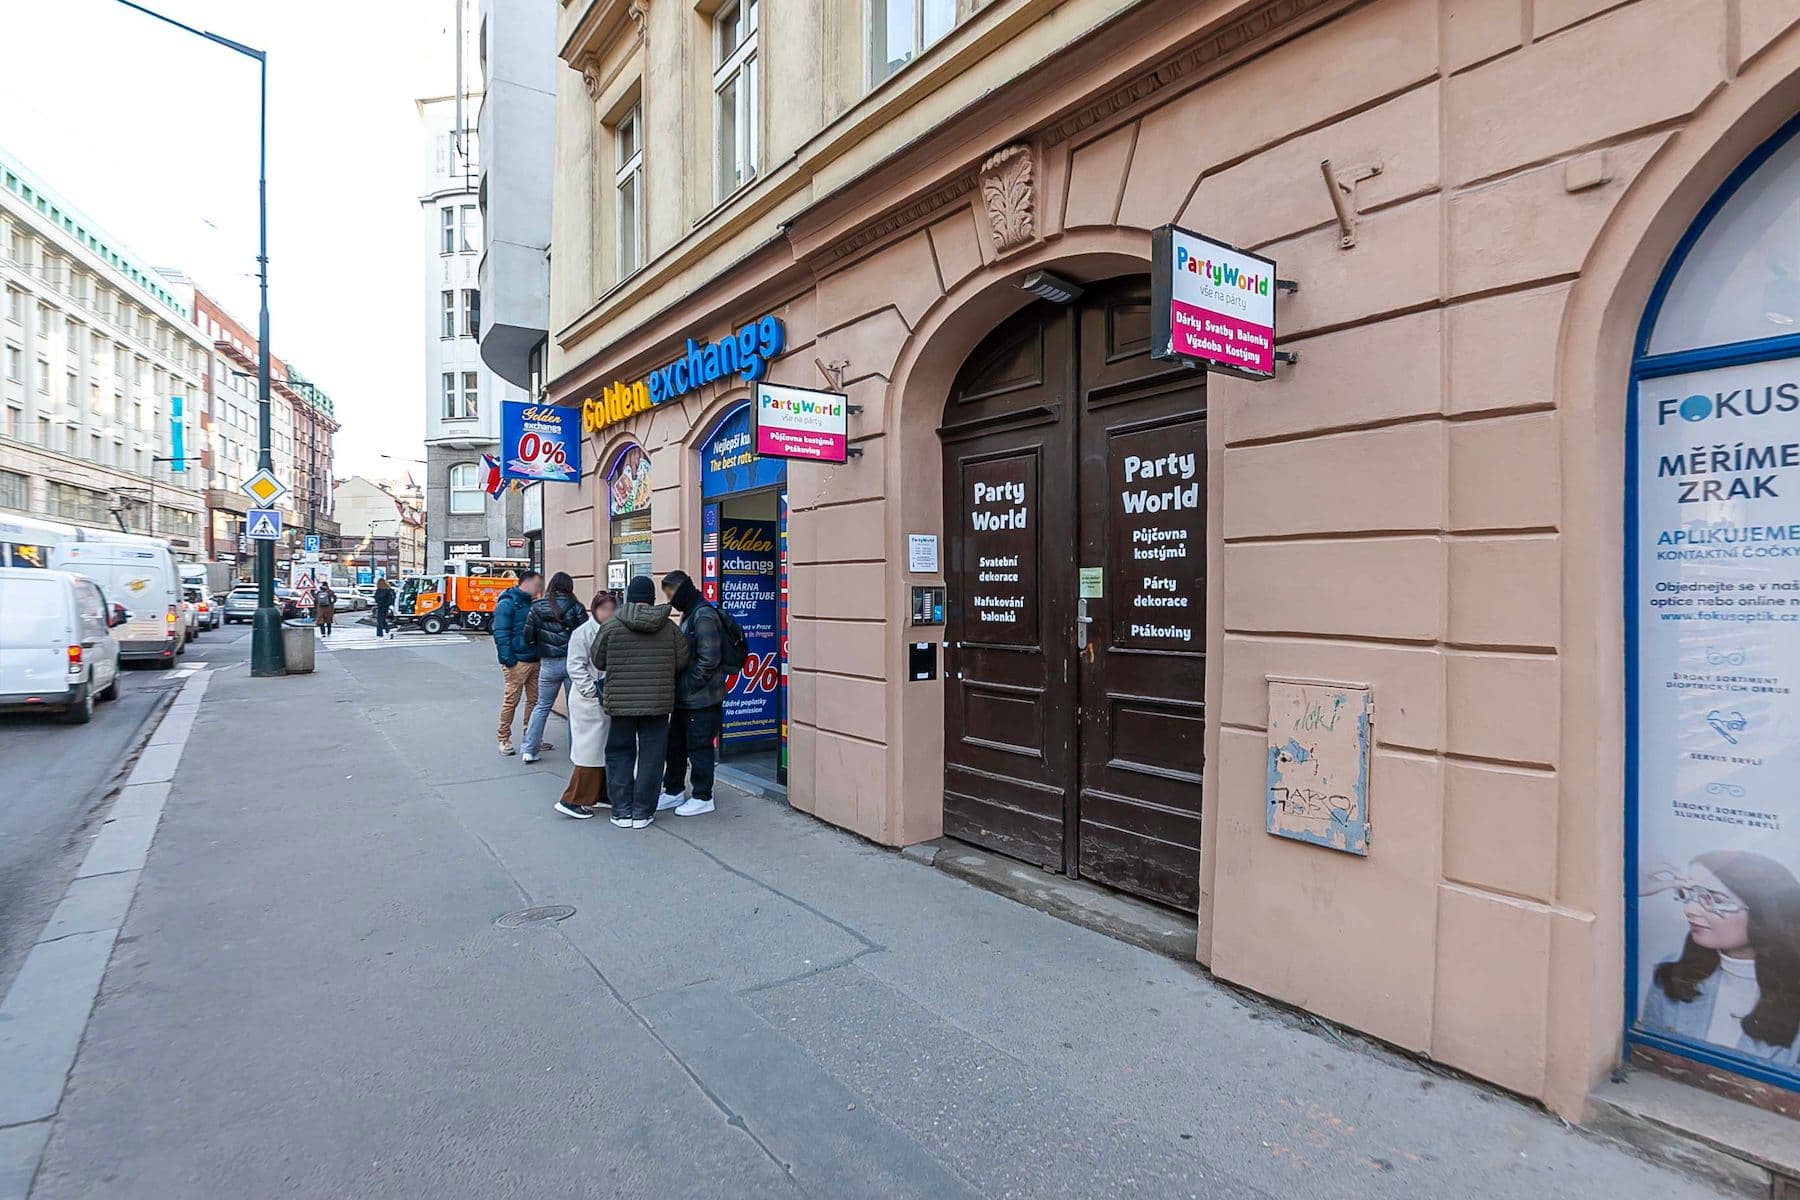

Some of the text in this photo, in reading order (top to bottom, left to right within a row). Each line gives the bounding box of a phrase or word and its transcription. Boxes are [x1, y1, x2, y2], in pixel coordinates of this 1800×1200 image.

[1199, 285, 1213, 297] vše
[1214, 290, 1224, 301] na
[1176, 311, 1269, 349] Dárky Svatby Balonky
[1186, 333, 1261, 364] Výzdoba Kostýmy
[522, 406, 562, 423] Golden
[583, 380, 650, 433] Golden
[713, 432, 751, 456] Nejlepší ku
[770, 431, 834, 446] Půjčovna kostýmů
[518, 431, 566, 466] 0%
[785, 444, 821, 456] Ptákoviny
[711, 459, 721, 472] The
[722, 455, 737, 469] best
[1124, 452, 1196, 483] Party
[1658, 442, 1800, 478] MĚŘÍME
[974, 481, 1025, 505] Party
[1678, 475, 1779, 503] ZRAK
[1122, 483, 1199, 514] World
[972, 507, 1027, 531] World
[722, 526, 773, 552] Golden
[1133, 527, 1187, 545] Půjčovna
[1657, 525, 1800, 546] APLIKUJEME
[1134, 543, 1186, 561] kostýmů
[1657, 545, 1800, 561] KONTAKTNÍ ČOČKY
[979, 555, 1019, 567] Svatební
[979, 571, 1018, 582] dekorace
[1143, 576, 1177, 592] Párty
[1655, 582, 1734, 594] Objednejte
[1739, 583, 1755, 591] se
[1772, 580, 1800, 591] naš
[722, 592, 775, 601] CHSELSTUBE
[974, 596, 1024, 608] Nafukování
[1134, 595, 1188, 607] dekorace
[1650, 597, 1693, 608] optice
[1697, 596, 1733, 606] nebo
[1738, 595, 1785, 606] online
[981, 610, 1016, 623] balonků
[1661, 611, 1799, 624] www.fokusoptik.cz
[1131, 624, 1192, 641] Ptákoviny
[1666, 681, 1747, 692] DIOPTRICKÝCH
[1673, 672, 1779, 685] ŠIROKÝ SORTIMENT
[1690, 753, 1727, 762] SERVIS
[1672, 800, 1779, 820] ŠIROKÝ SORTIMENT
[1674, 810, 1744, 825] SLUNEČNÍCH
